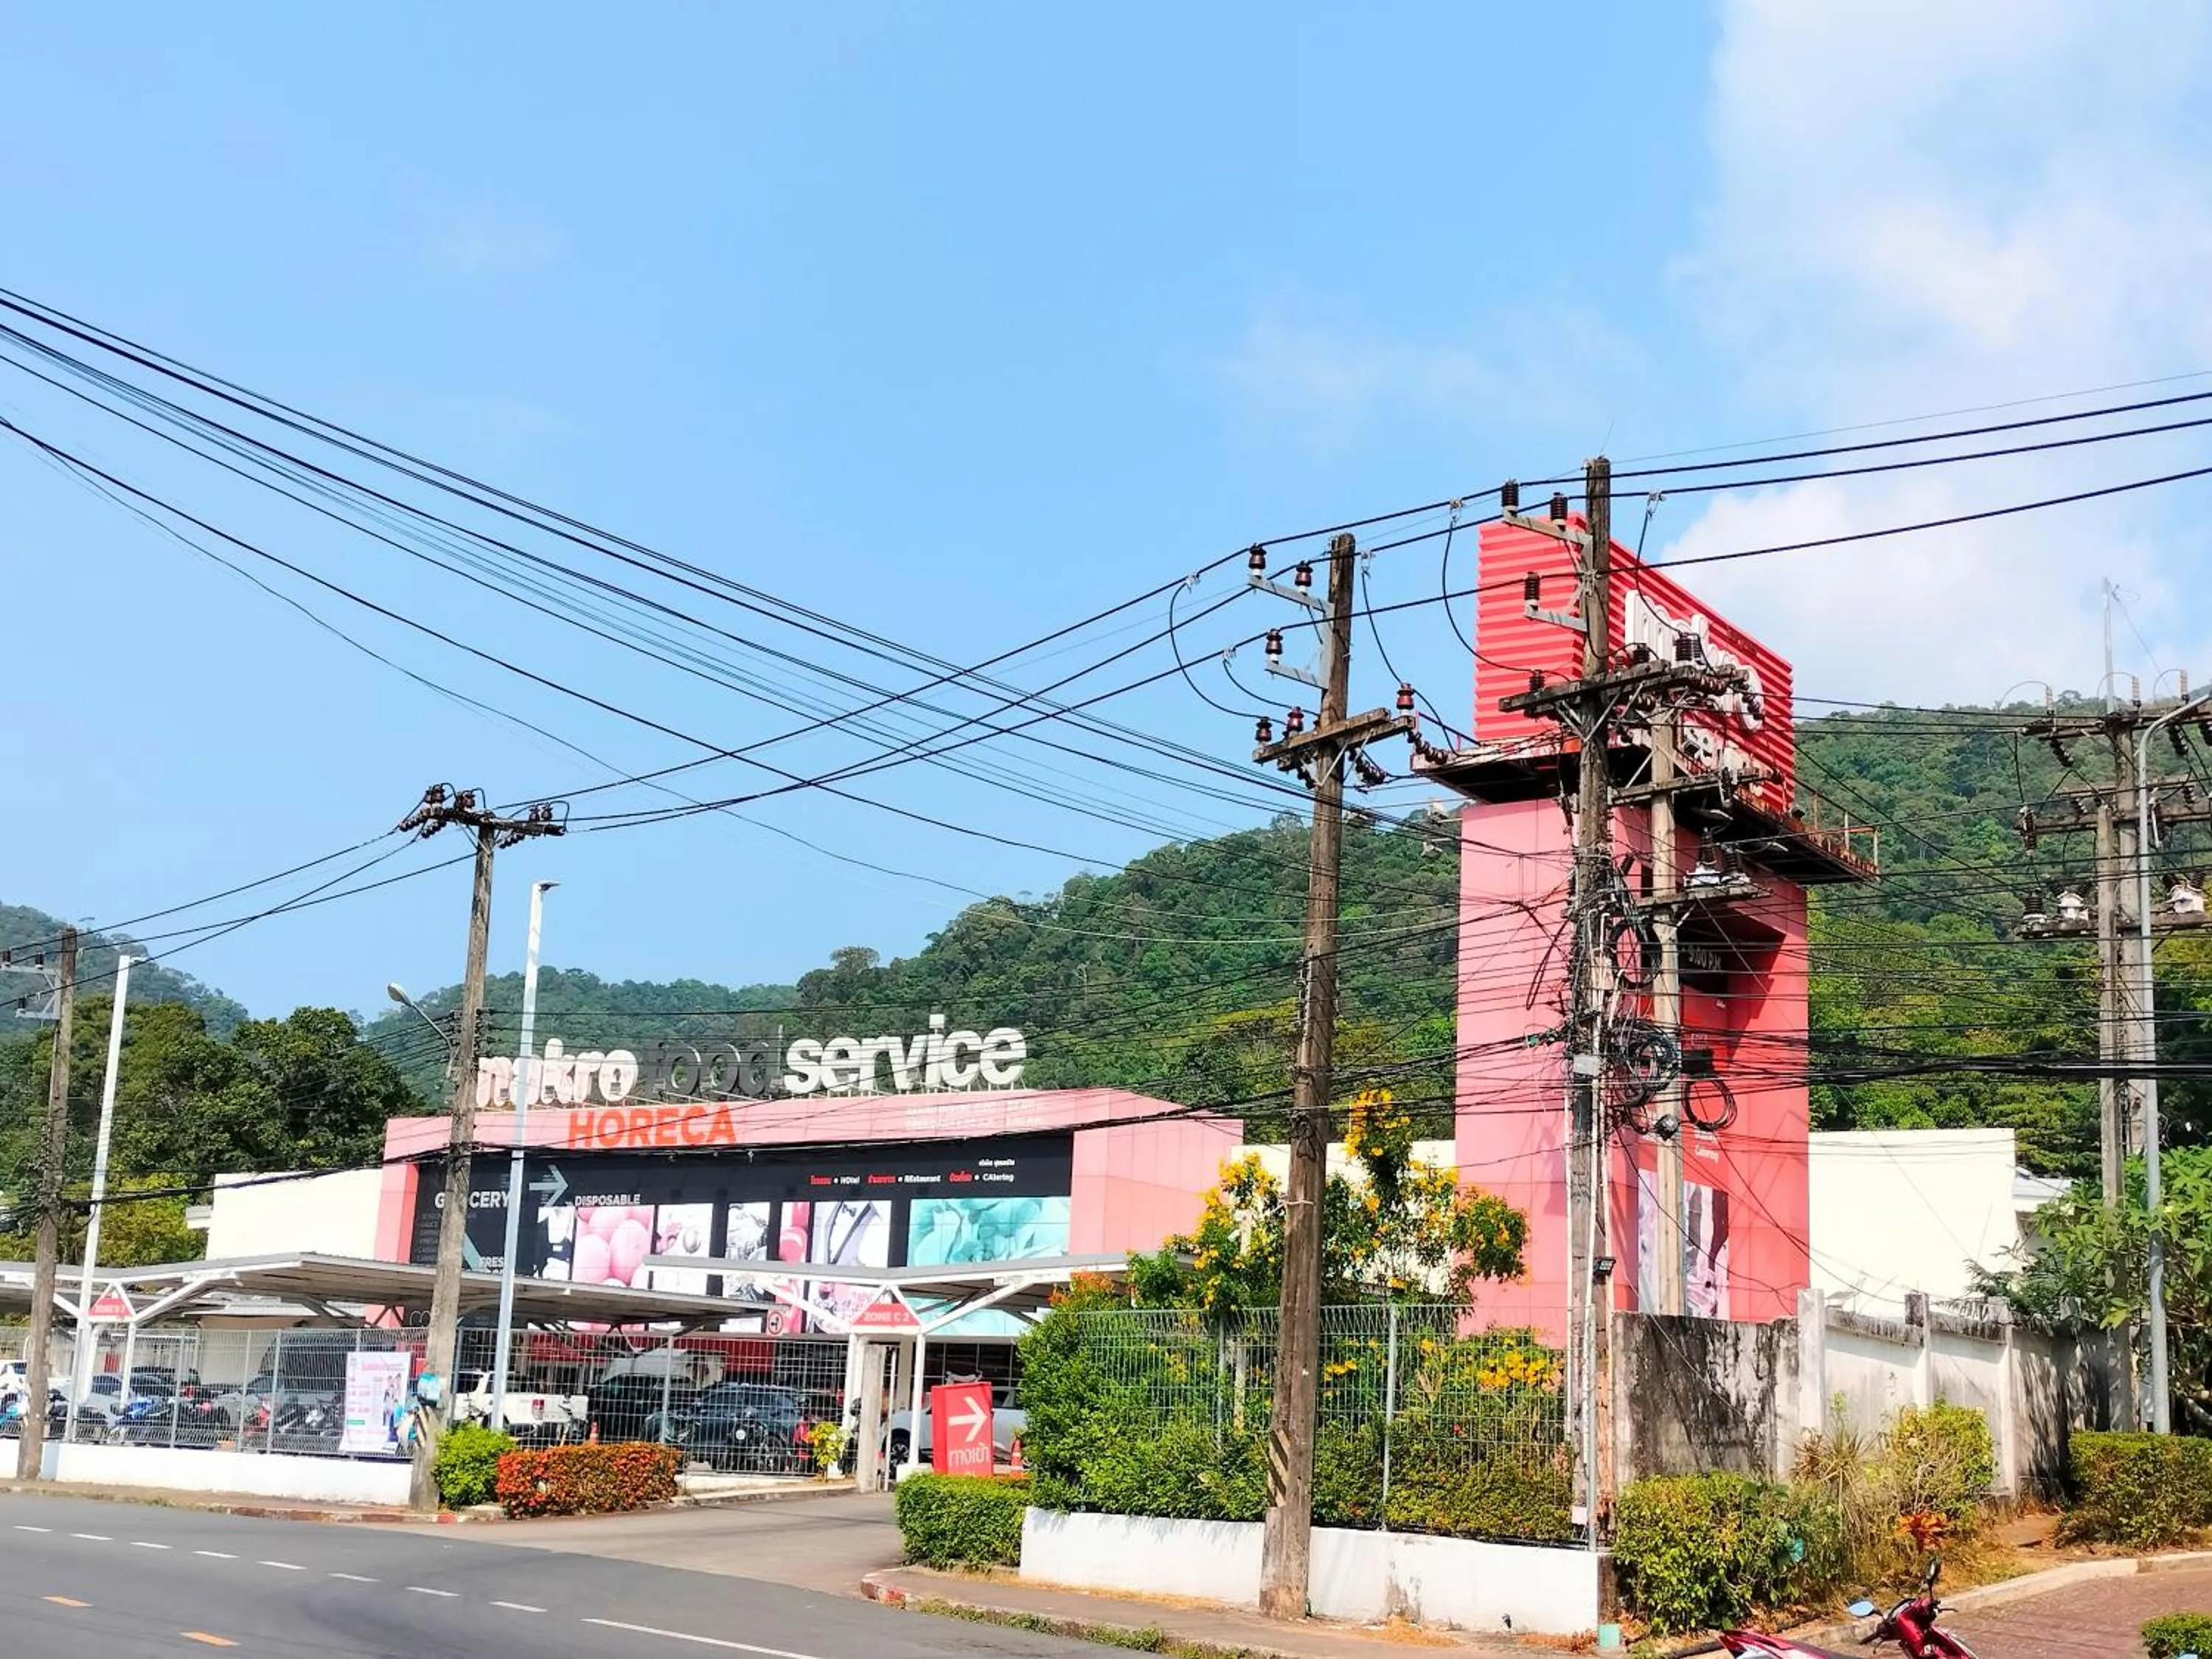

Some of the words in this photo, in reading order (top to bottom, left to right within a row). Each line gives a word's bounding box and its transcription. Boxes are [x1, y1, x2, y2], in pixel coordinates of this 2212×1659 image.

[784, 1013, 1027, 1094] service
[568, 1105, 737, 1148] HORECA
[434, 1191, 511, 1209] GCERY
[574, 1193, 641, 1206] DISPOSABLE
[863, 1312, 892, 1322] ZONE
